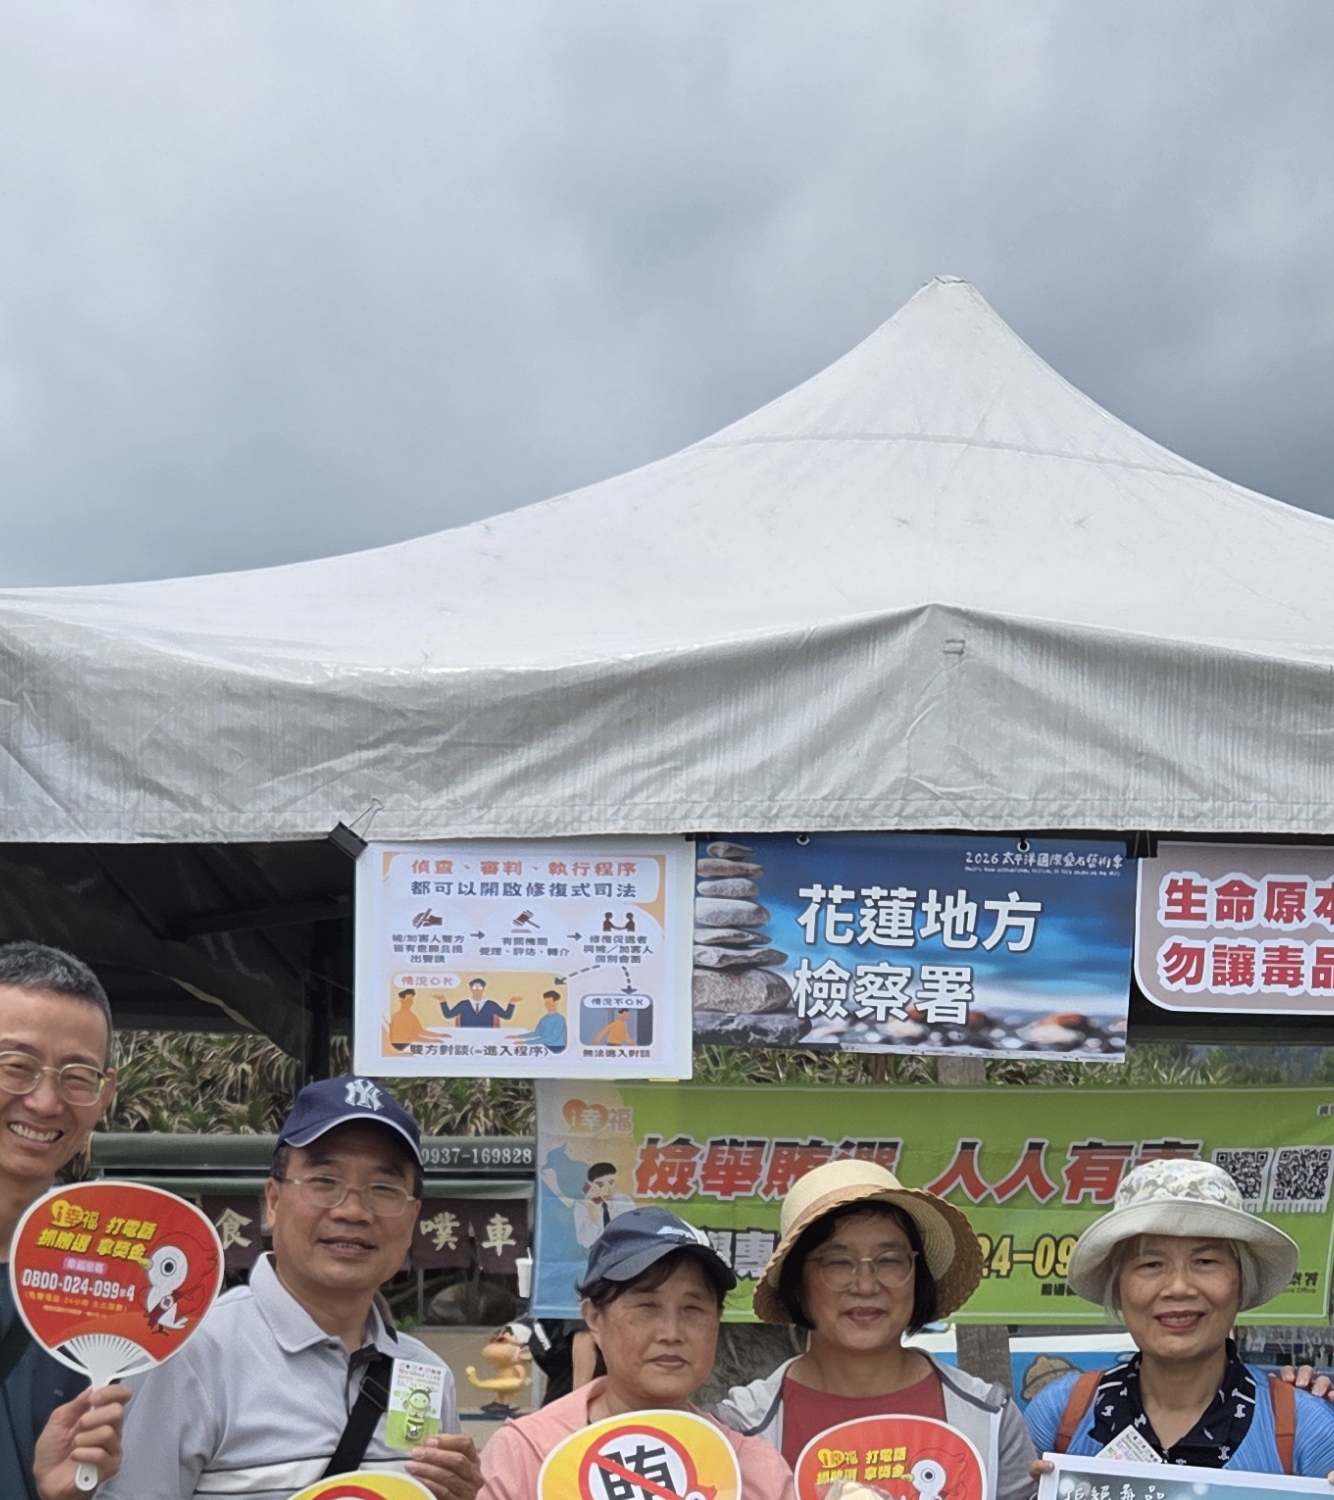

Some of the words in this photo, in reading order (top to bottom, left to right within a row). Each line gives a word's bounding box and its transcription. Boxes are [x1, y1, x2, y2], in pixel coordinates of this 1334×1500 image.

[411, 859, 637, 877] 偵查、審判、執行程序
[410, 880, 637, 898] 都可以開啟修復式司法
[796, 884, 1042, 952] 花蓮地方
[793, 958, 975, 1026] 檢察署
[422, 1148, 532, 1164] 0937-169828
[928, 1141, 1200, 1201] 人人有
